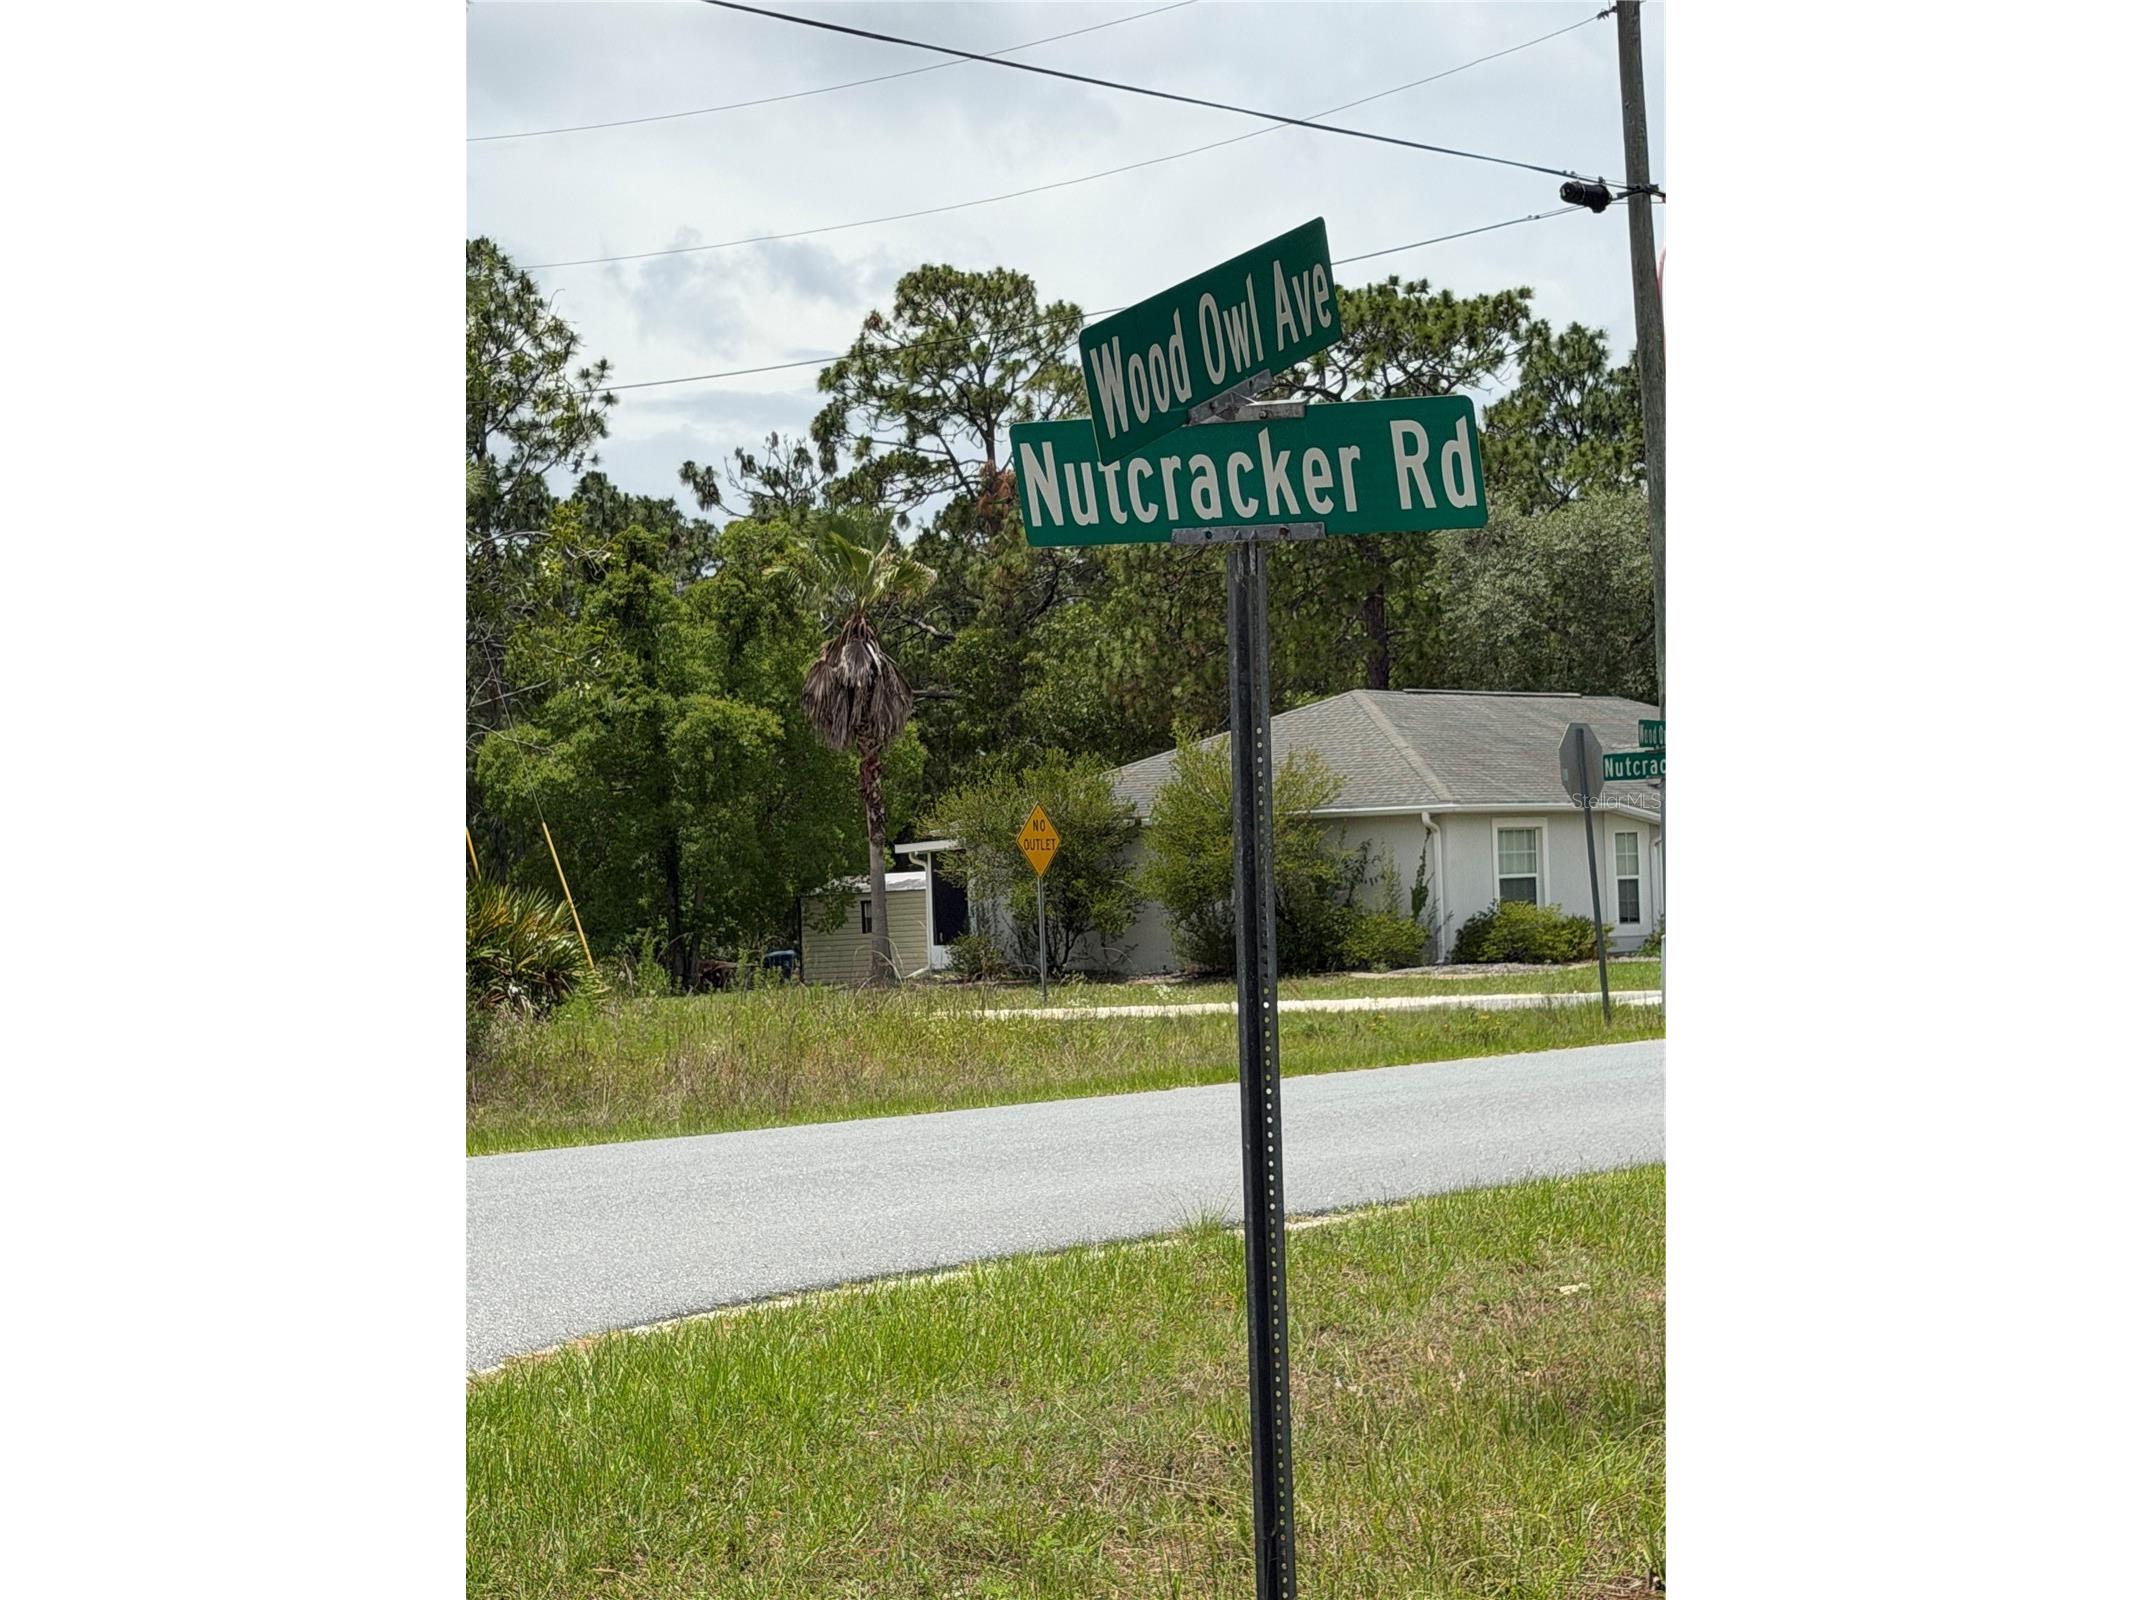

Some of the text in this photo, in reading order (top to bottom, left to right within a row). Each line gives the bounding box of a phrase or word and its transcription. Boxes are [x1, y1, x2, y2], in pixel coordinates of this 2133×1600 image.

[1089, 259, 1332, 440] Wood Owl Ave
[1019, 416, 1479, 528] Nutcracker Rd
[1024, 839, 1056, 850] OUTLET
[1033, 820, 1045, 831] NO
